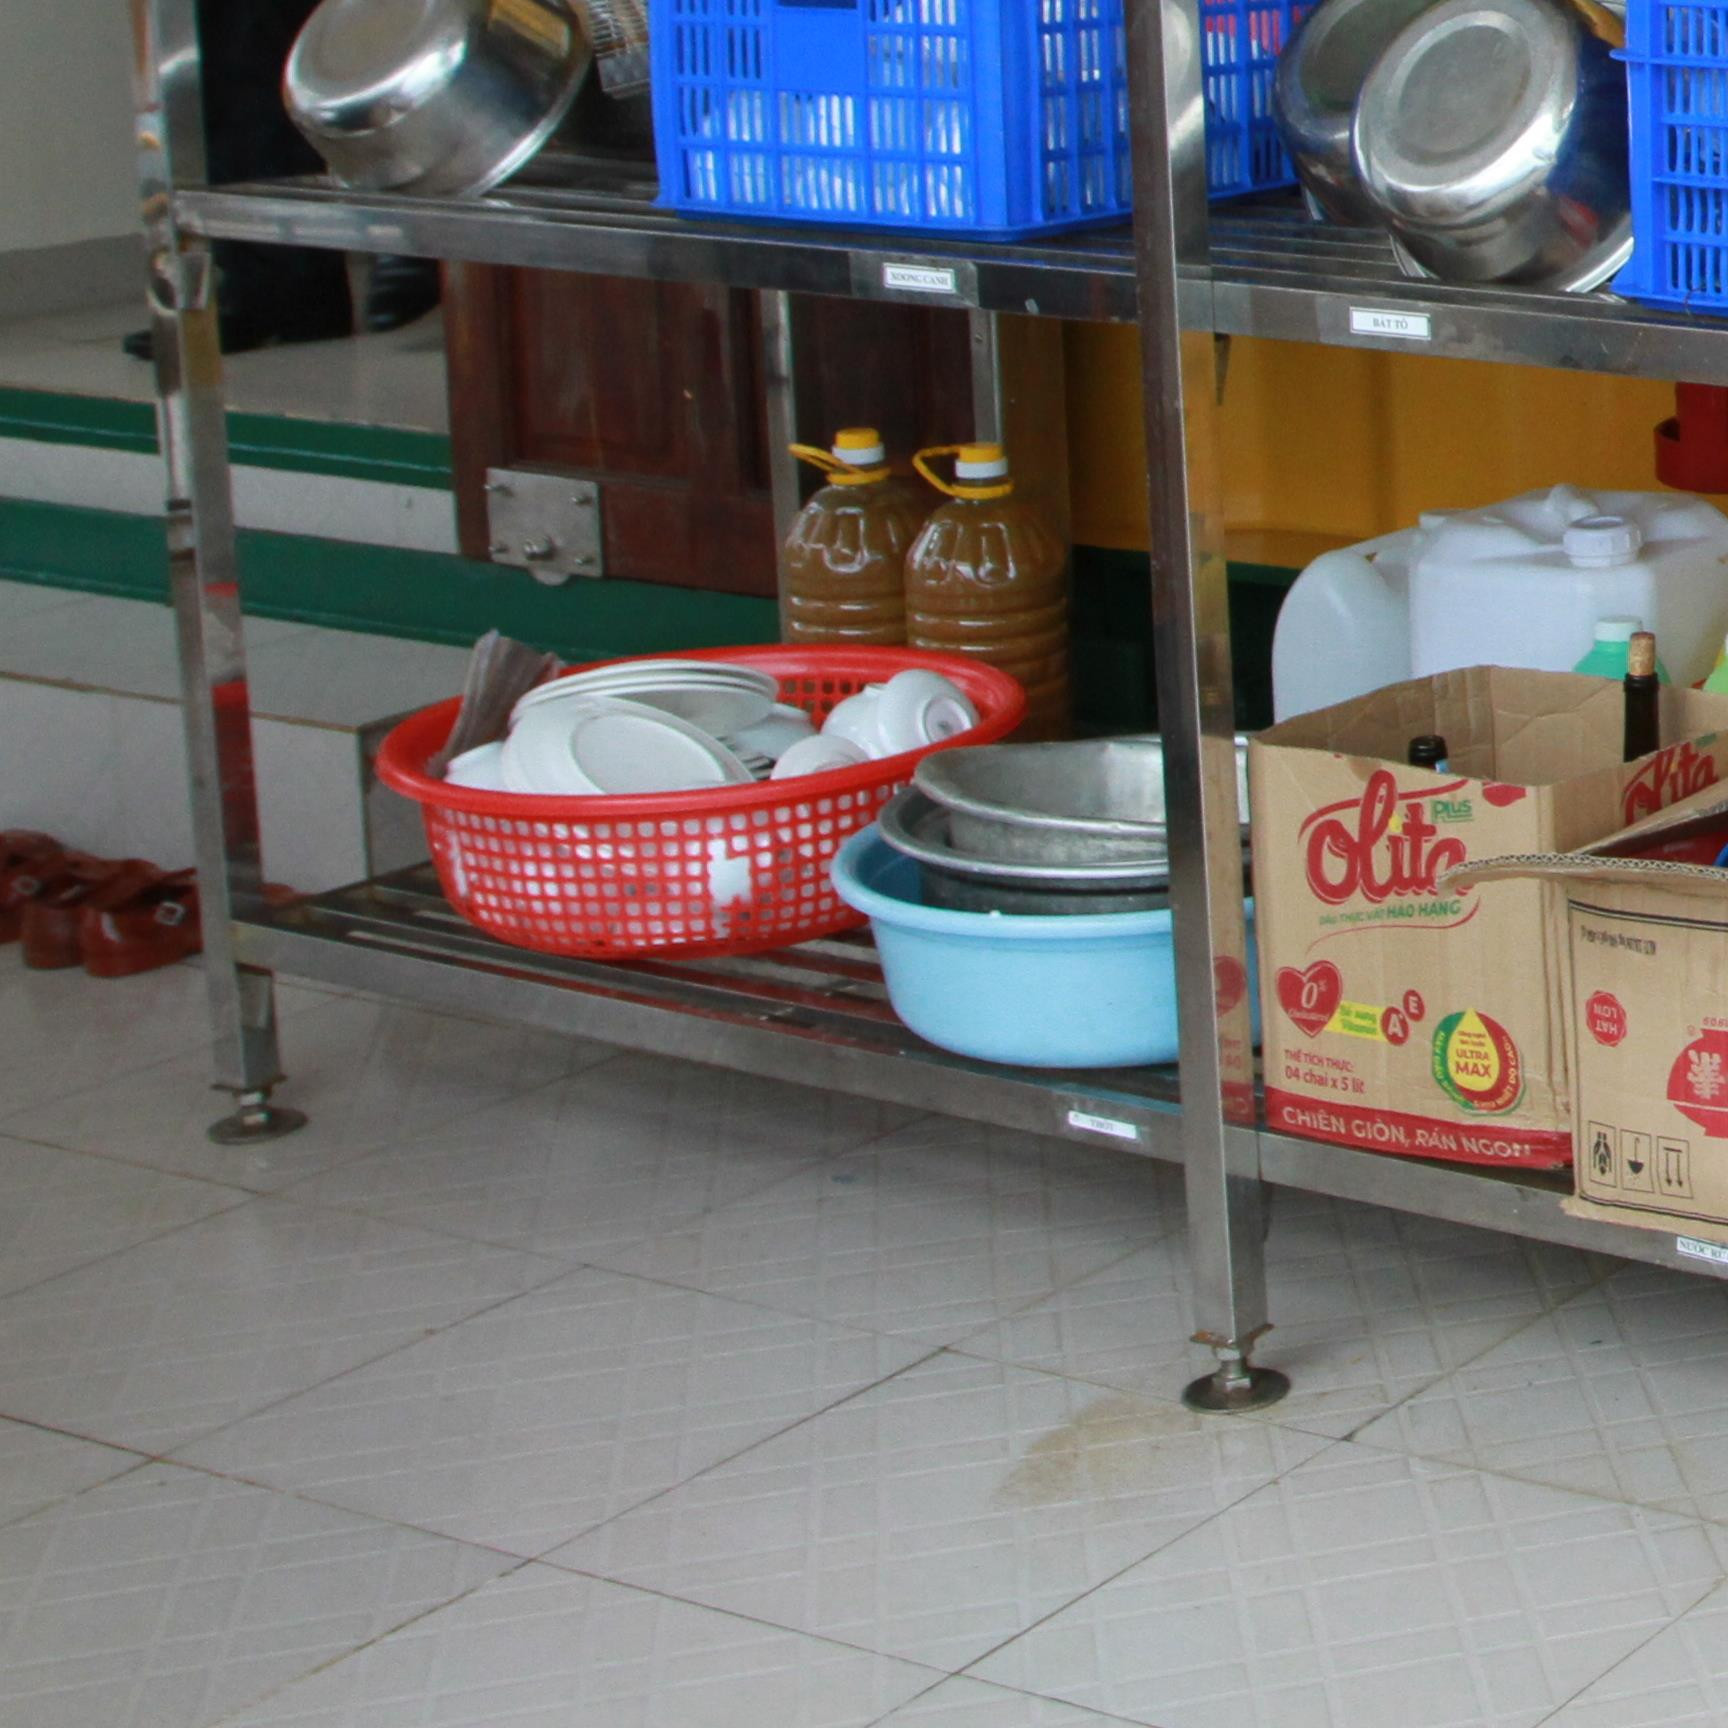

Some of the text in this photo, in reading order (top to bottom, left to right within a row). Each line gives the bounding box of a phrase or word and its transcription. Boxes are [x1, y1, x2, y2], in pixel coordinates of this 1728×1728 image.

[1388, 1013, 1404, 1038] A
[1455, 1061, 1492, 1078] MAX
[1341, 1076, 1349, 1091] 5
[1282, 1106, 1346, 1134] CHIÊN
